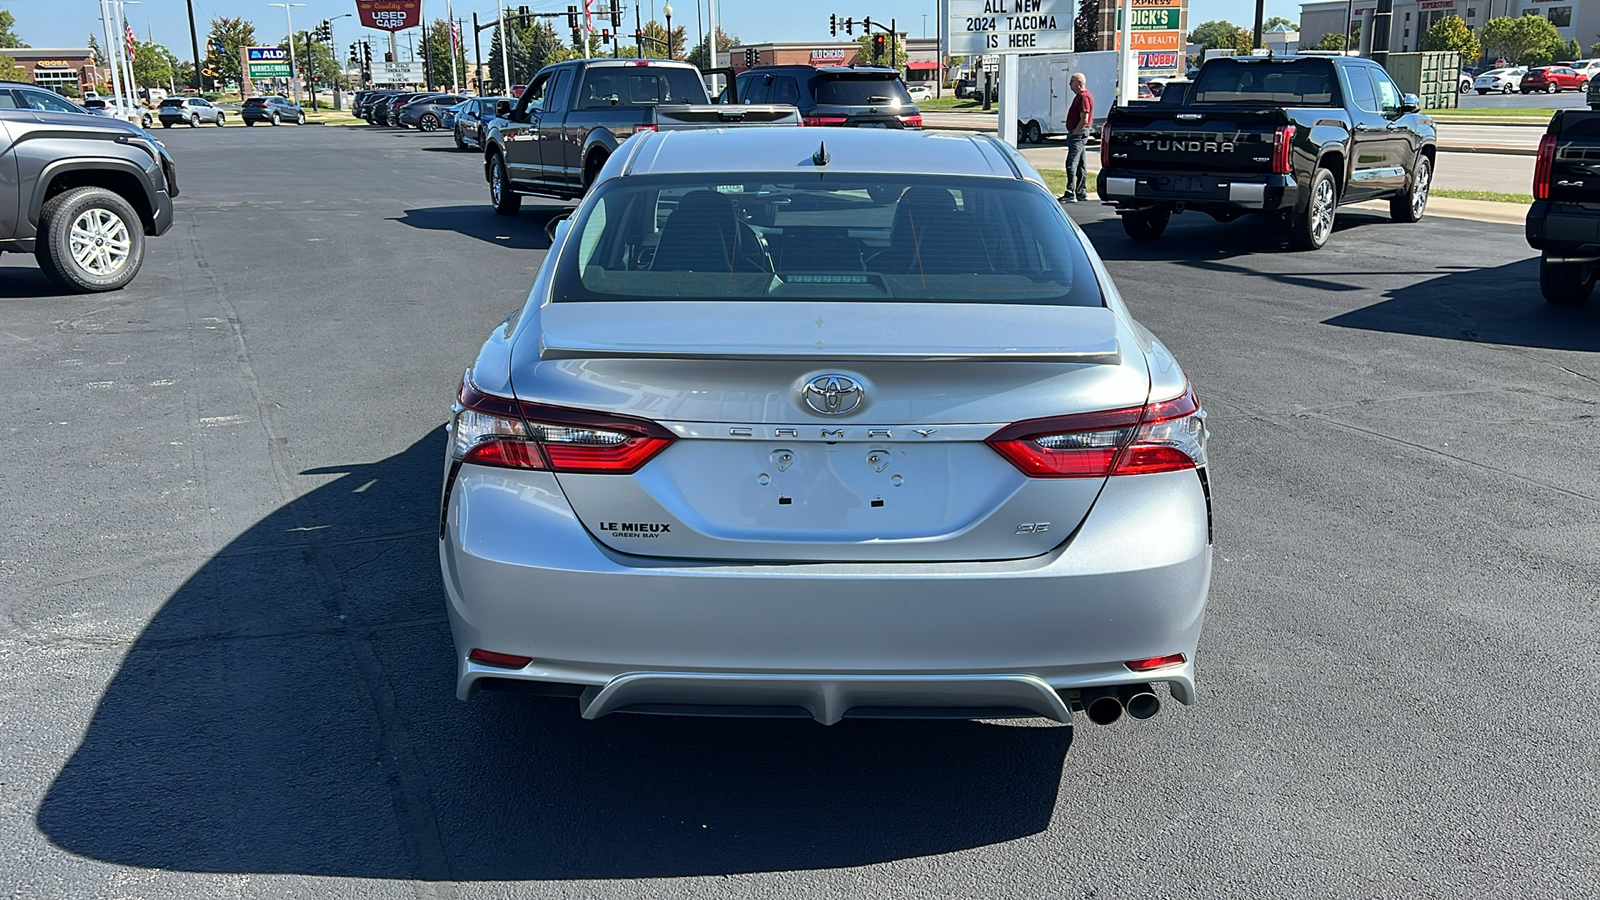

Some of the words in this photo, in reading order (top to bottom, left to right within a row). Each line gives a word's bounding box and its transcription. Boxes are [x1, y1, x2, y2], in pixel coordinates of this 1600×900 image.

[984, 0, 1007, 13] ALL
[1015, 0, 1041, 13] NEW
[371, 11, 407, 20] USED
[1131, 10, 1169, 25] DICK'S
[376, 19, 404, 28] CARS
[966, 17, 996, 31] 2024
[1006, 15, 1057, 31] TACOMA
[986, 34, 998, 48] IS
[1009, 33, 1036, 48] HERE
[1147, 35, 1178, 45] BEAUTY
[812, 49, 823, 58] OLD
[823, 49, 845, 58] CHICAGO
[1149, 53, 1177, 66] LOBBY
[1143, 139, 1235, 153] TUNDRA
[729, 427, 939, 438] CAMRY
[600, 522, 618, 531] LE
[621, 522, 671, 532] MIEUX
[1015, 522, 1051, 535] SE
